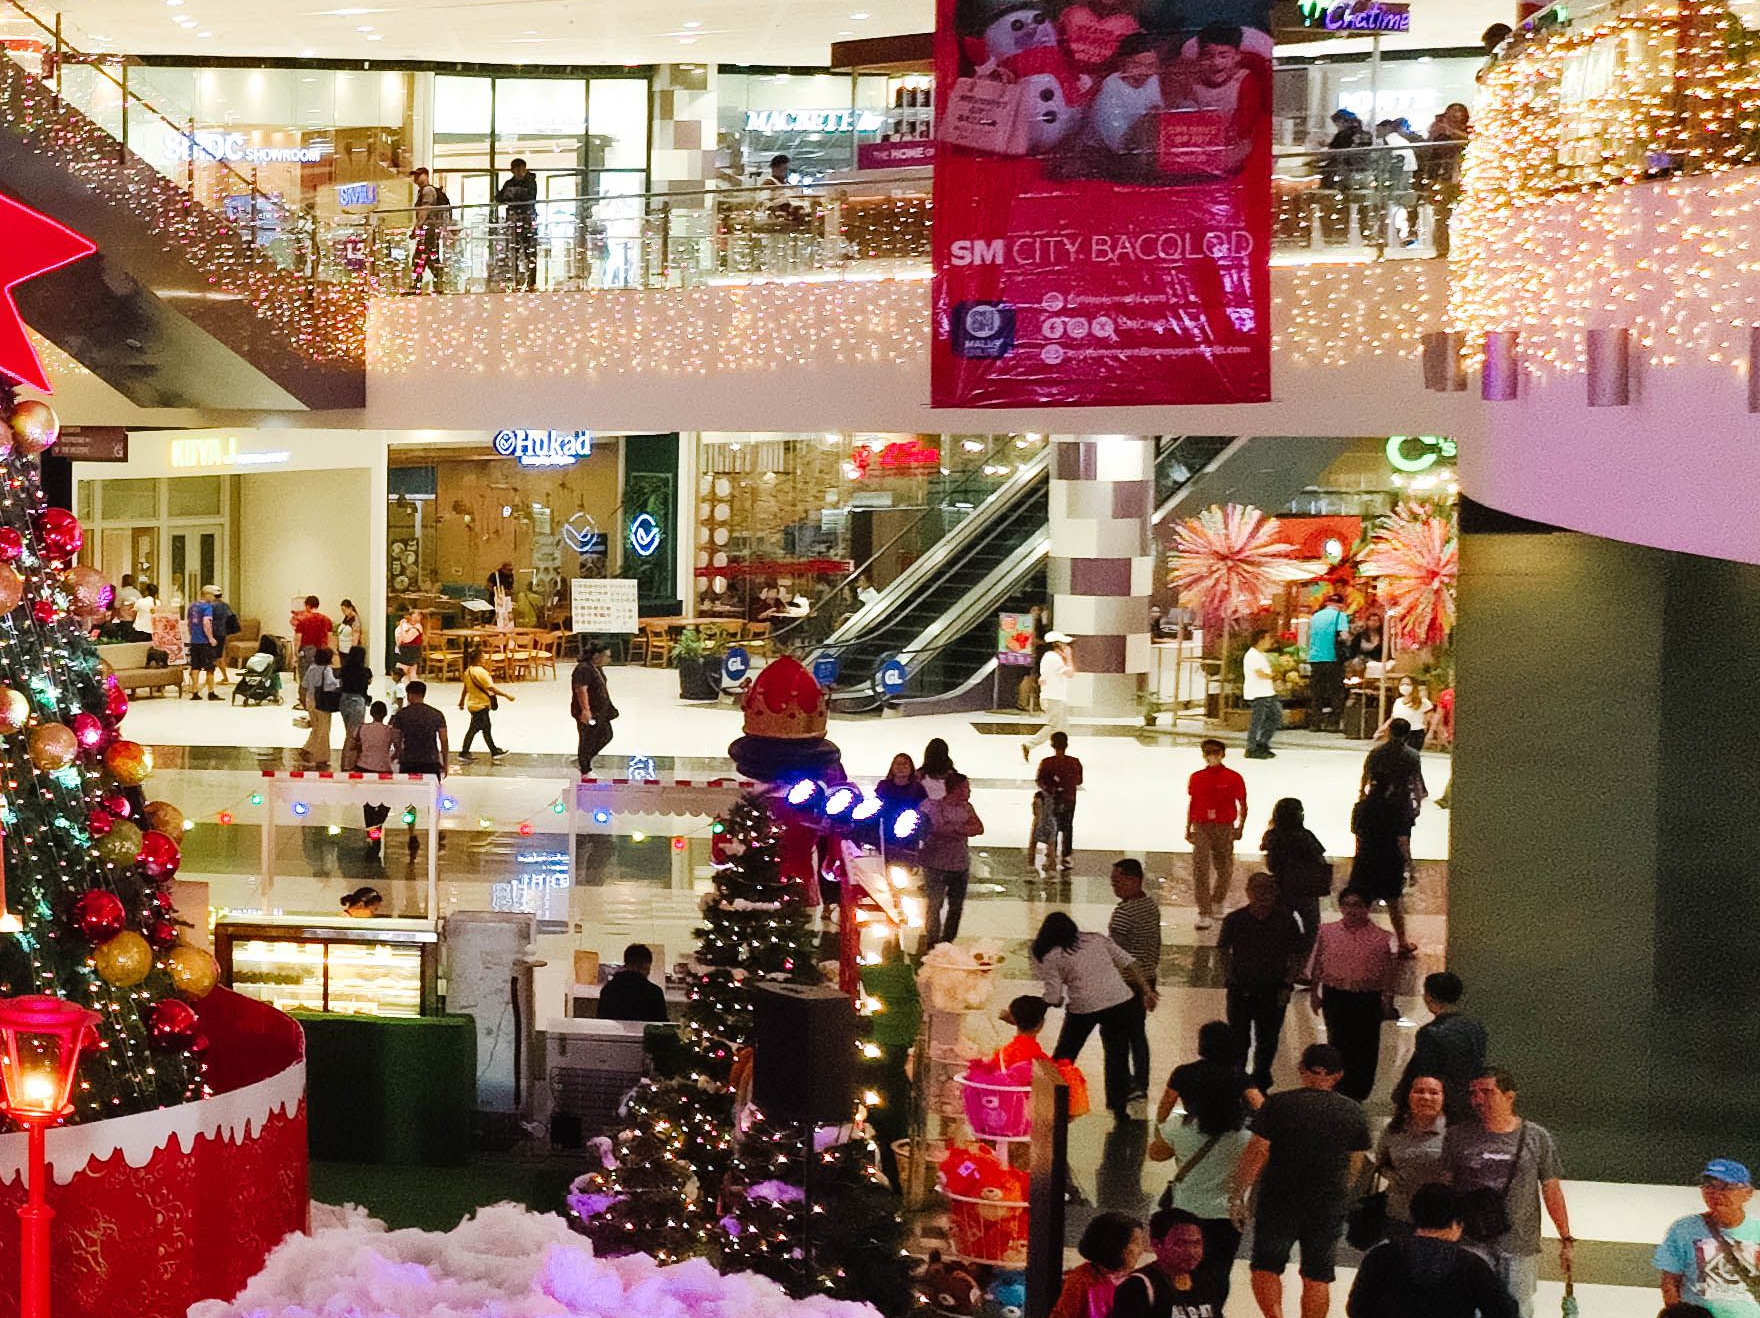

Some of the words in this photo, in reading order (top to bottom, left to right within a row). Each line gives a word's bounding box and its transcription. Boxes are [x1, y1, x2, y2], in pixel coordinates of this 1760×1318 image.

[244, 146, 322, 164] SHOWROOM
[890, 147, 925, 160] HOME
[950, 239, 1005, 266] SM
[1013, 236, 1083, 265] CITY
[1091, 230, 1254, 263] BACOLOD
[514, 429, 592, 457] Hukad
[727, 656, 746, 672] GL
[884, 670, 904, 685] GL
